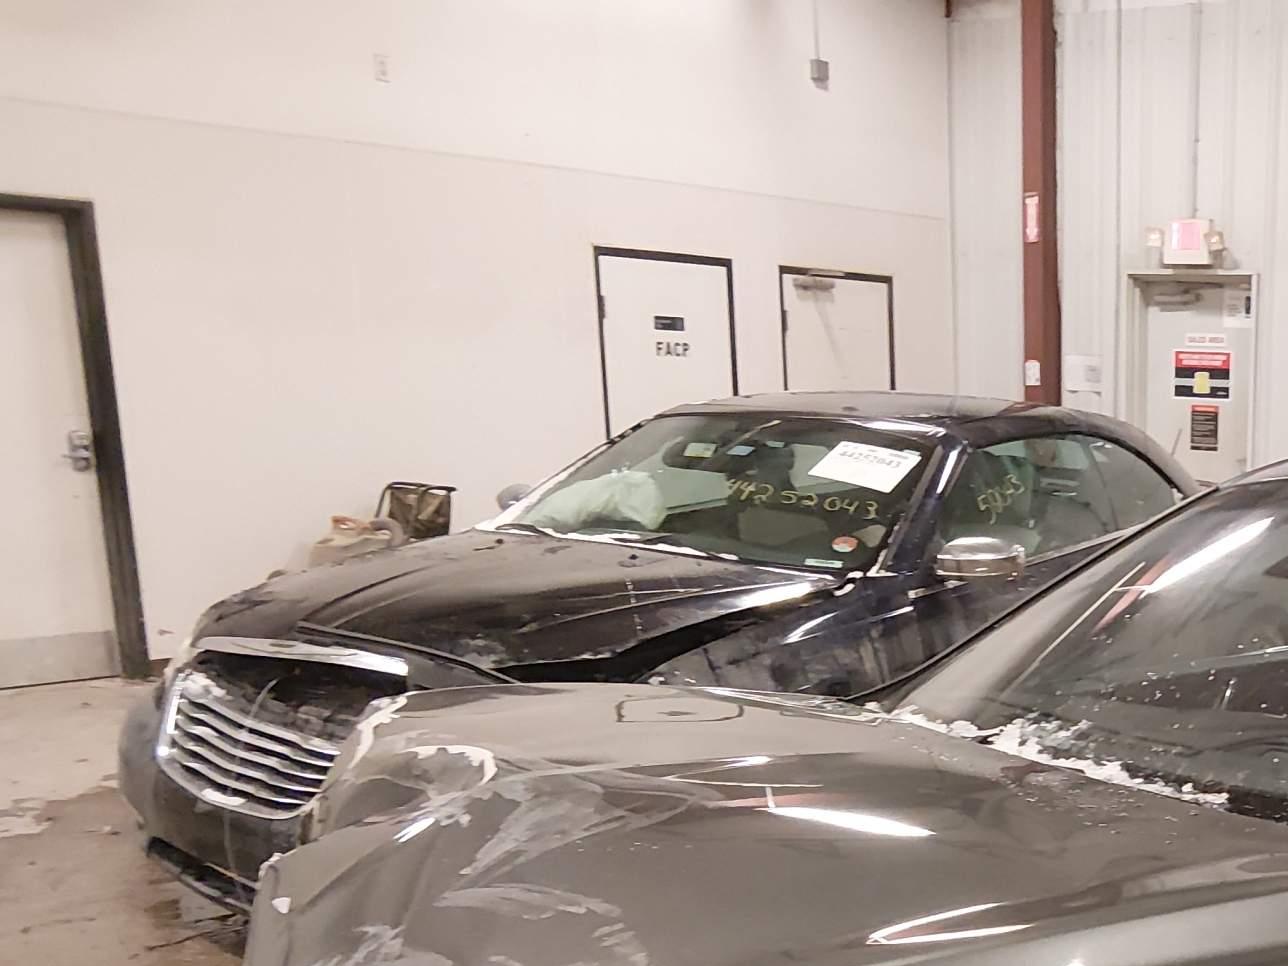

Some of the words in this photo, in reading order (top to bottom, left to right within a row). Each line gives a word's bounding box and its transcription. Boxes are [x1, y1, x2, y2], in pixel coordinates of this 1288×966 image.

[655, 341, 690, 357] FACP
[839, 450, 902, 469] 44252043
[726, 478, 879, 520] 44252043
